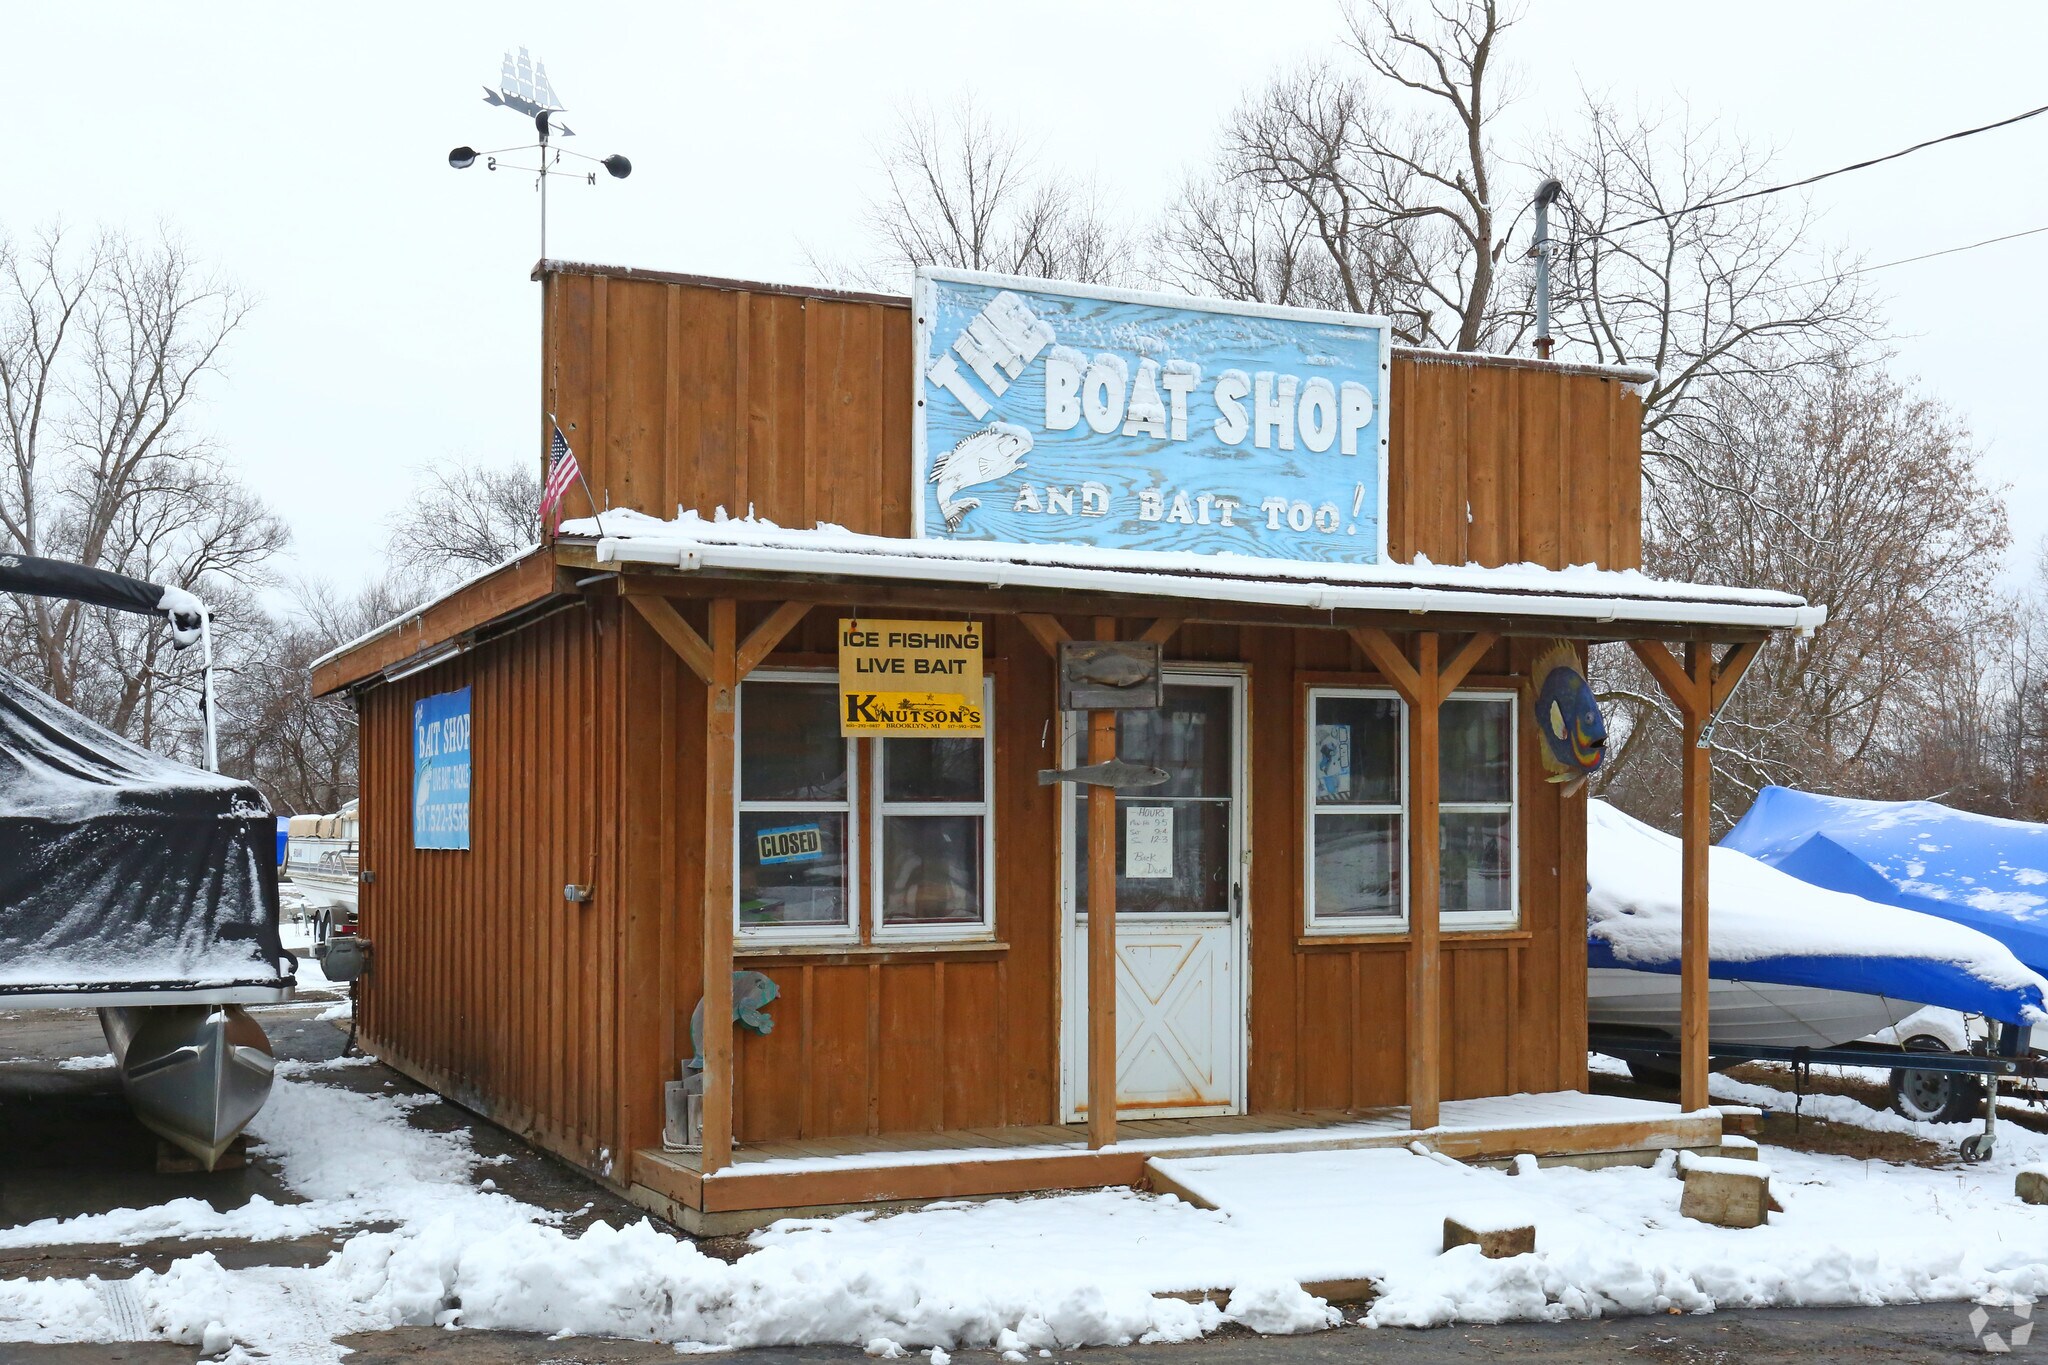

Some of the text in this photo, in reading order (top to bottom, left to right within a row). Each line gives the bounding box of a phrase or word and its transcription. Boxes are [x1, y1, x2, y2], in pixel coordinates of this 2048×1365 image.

[927, 291, 1055, 421] THE
[1044, 346, 1373, 456] BOAT SHOP
[1012, 481, 1110, 518] AND
[1138, 488, 1240, 527] BAIT
[843, 631, 979, 649] ICE FISHING
[856, 658, 967, 674] LIVE BAIT
[419, 713, 470, 759] BAIT SHOP
[1138, 808, 1166, 817] HOURS
[760, 831, 818, 858] CLOSED
